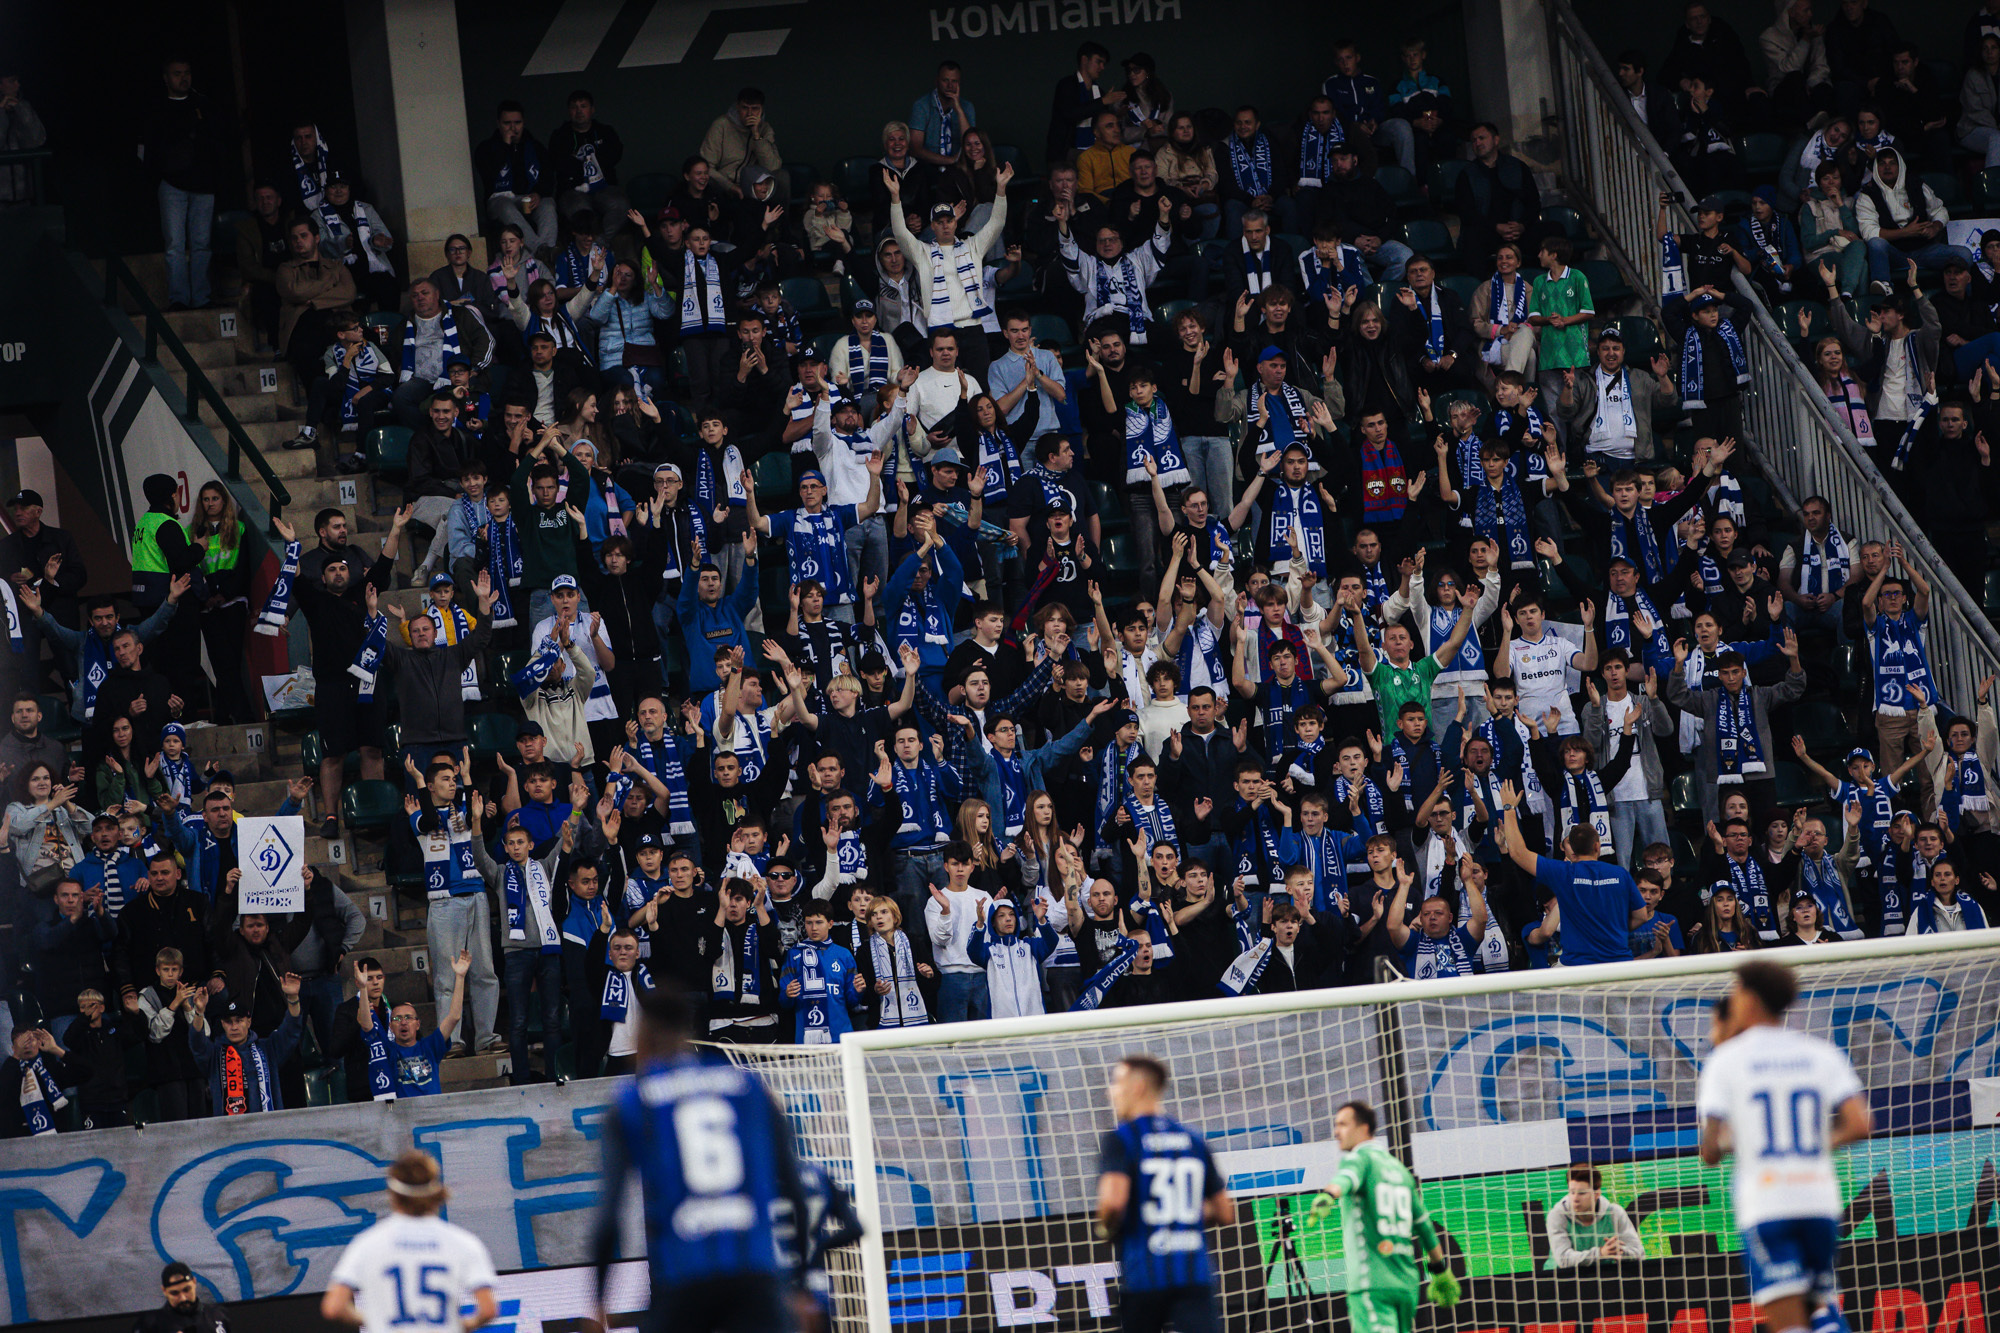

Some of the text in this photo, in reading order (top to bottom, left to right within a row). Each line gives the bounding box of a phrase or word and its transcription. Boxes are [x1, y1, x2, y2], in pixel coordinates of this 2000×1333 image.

[221, 319, 235, 332] 17
[261, 374, 276, 387] 16
[1367, 480, 1386, 490] ЦСКА
[1390, 477, 1406, 486] ЦСКА
[340, 487, 355, 500] 14
[1521, 668, 1562, 681] BetBoom
[247, 734, 262, 747] 10
[334, 845, 341, 858] 8
[375, 902, 382, 916] 7
[417, 957, 424, 970] 6
[228, 1069, 237, 1092] ФК
[1750, 1087, 1821, 1157] 10
[673, 1096, 746, 1197] 6
[1139, 1158, 1205, 1225] 30
[1375, 1183, 1413, 1237] 99
[385, 1266, 448, 1325] 15
